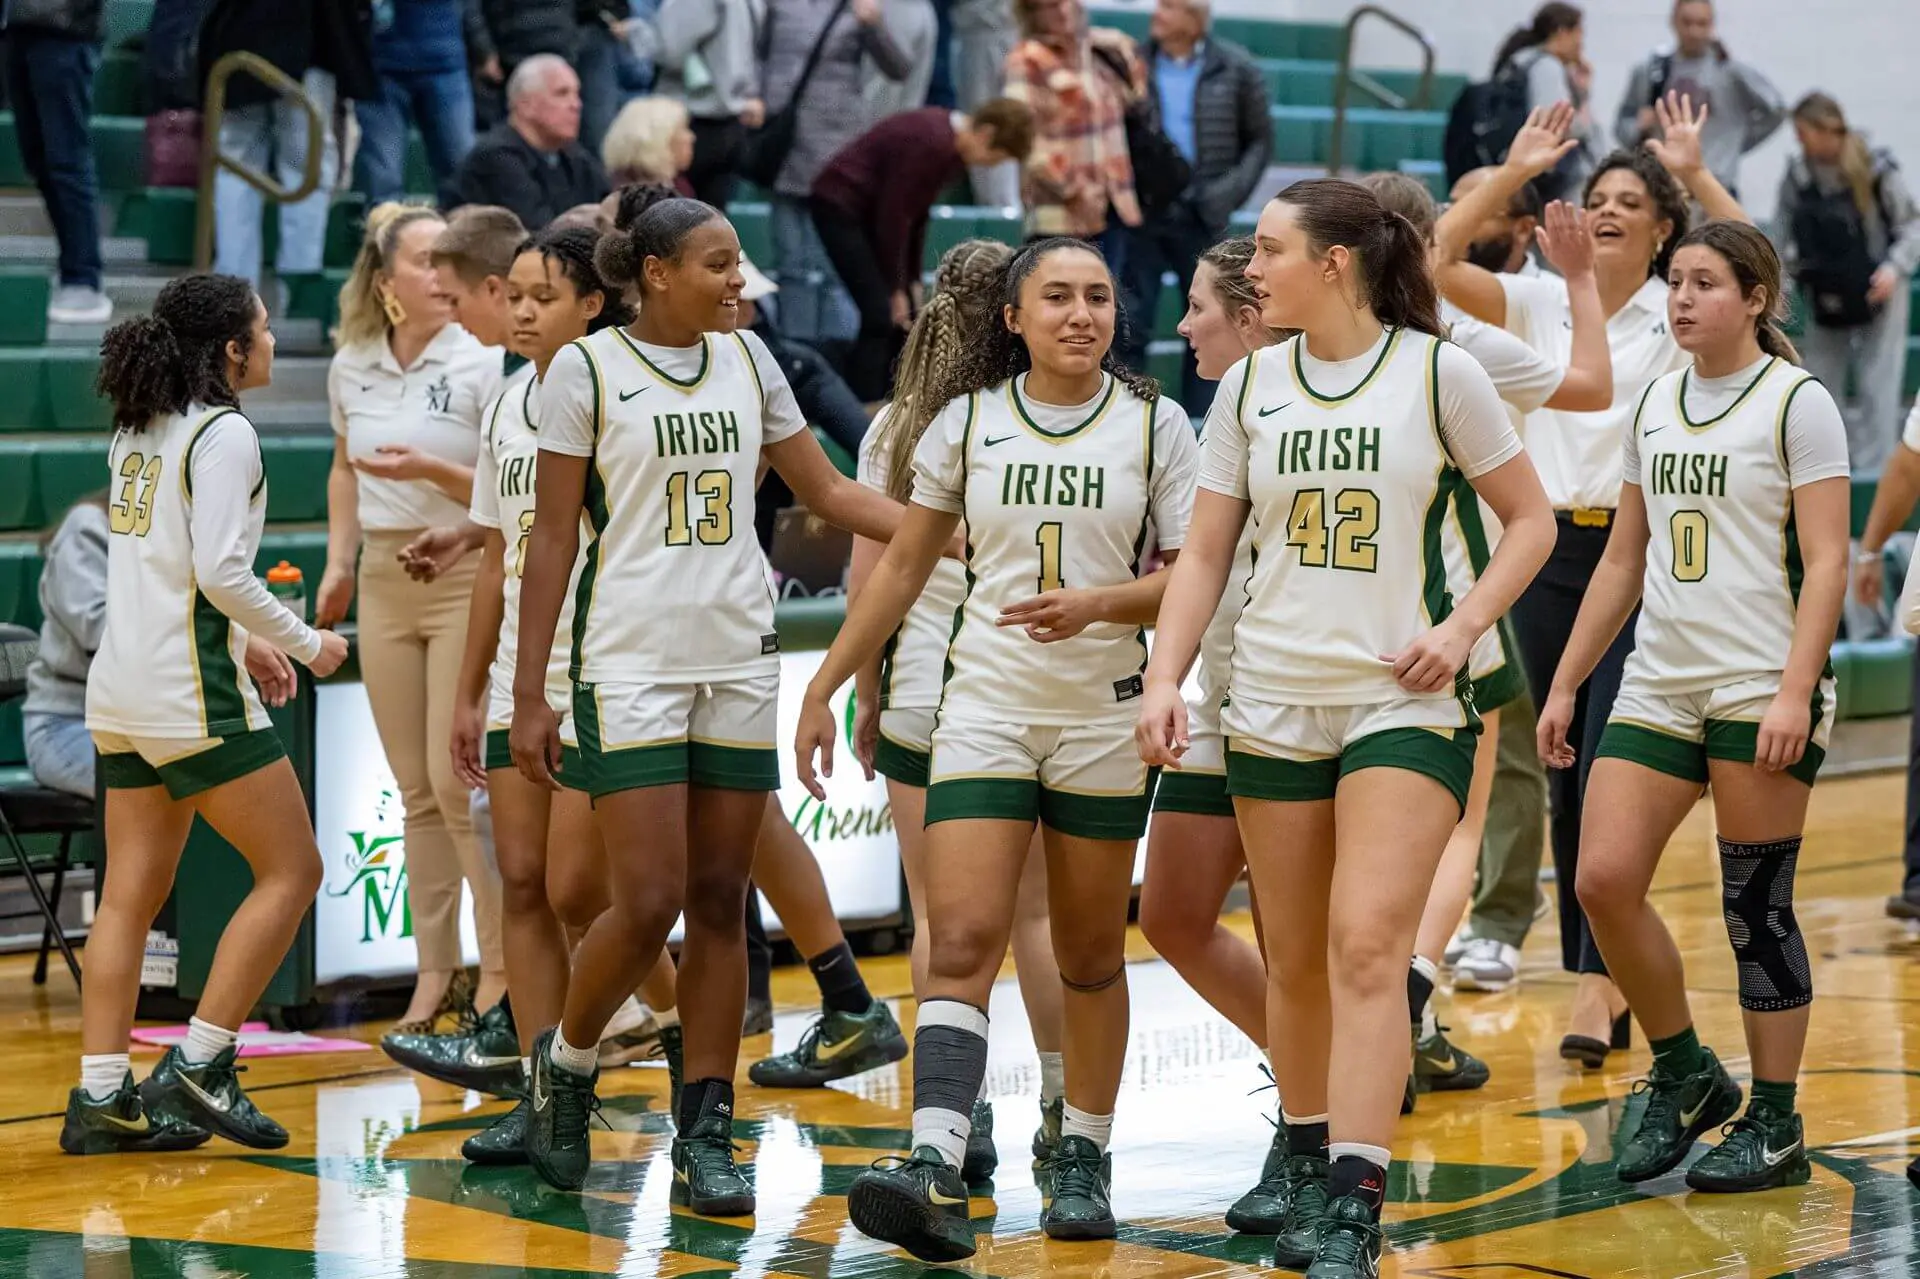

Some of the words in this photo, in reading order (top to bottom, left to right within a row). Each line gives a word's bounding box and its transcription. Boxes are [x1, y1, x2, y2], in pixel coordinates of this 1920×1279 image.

[653, 411, 740, 458] IRISH
[1278, 427, 1381, 475] IRISH
[109, 452, 163, 537] 33
[500, 456, 537, 497] IRI
[1002, 463, 1105, 509] IRISH
[1652, 453, 1728, 497] IRISH
[664, 469, 733, 547] 13
[1286, 488, 1381, 573] 42
[1035, 521, 1065, 594] 1
[1669, 509, 1709, 583] 0
